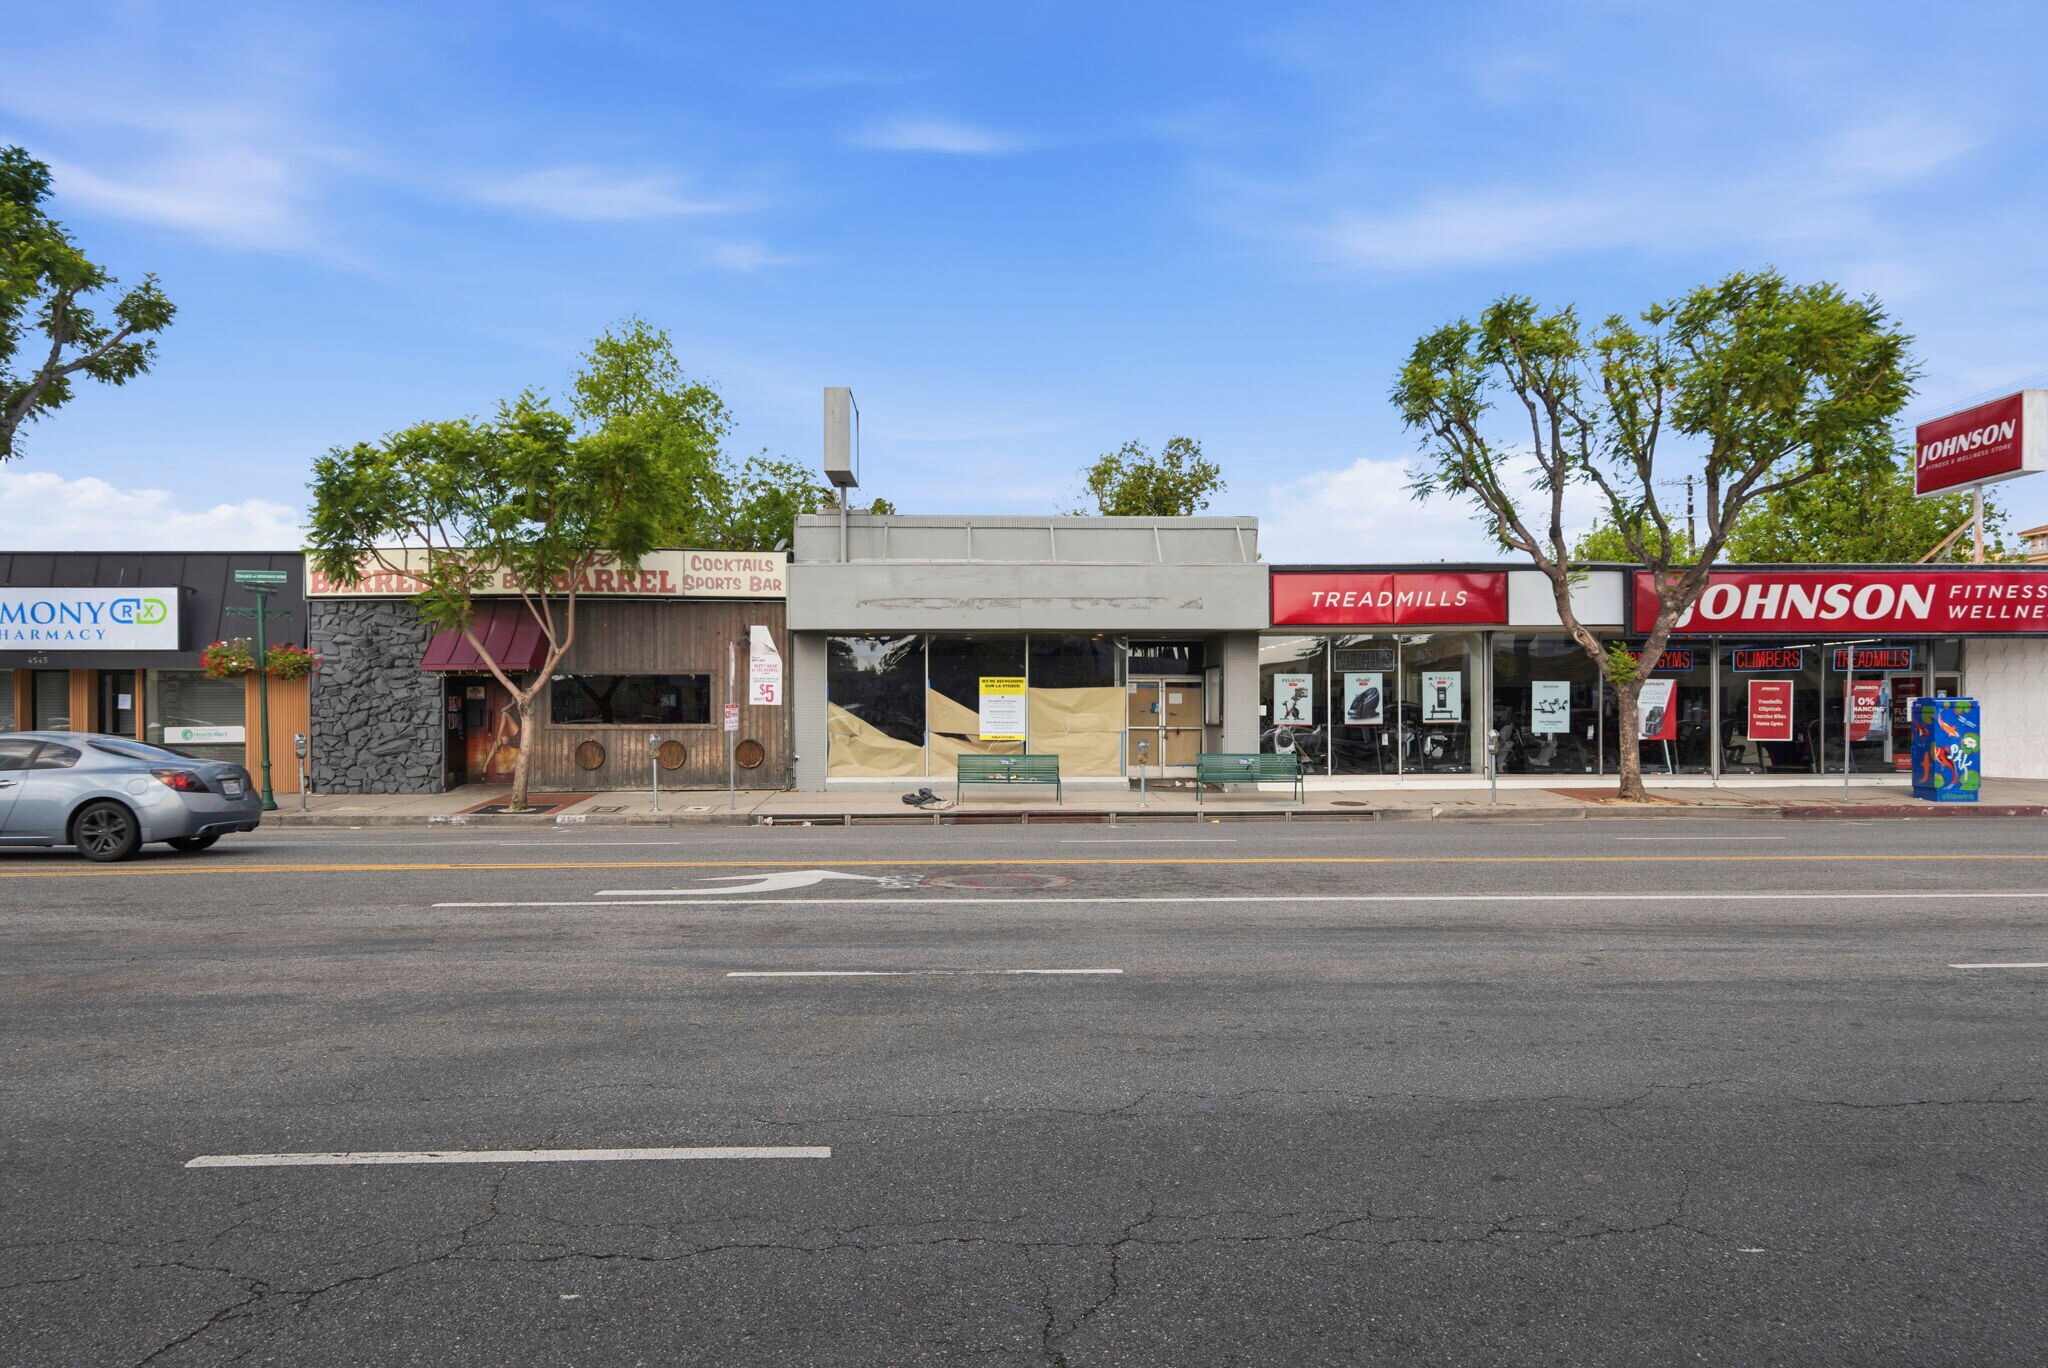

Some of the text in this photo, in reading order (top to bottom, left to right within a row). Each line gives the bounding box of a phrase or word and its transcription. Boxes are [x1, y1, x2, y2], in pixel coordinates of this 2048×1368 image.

[1919, 418, 2016, 468] JOHNSON
[1926, 460, 1949, 471] FITNESS
[1957, 449, 1988, 462] WELLNESS
[1990, 443, 2012, 454] STORE
[691, 555, 774, 573] COCKTAILS
[683, 574, 782, 592] SPORTS BAR
[1949, 585, 2048, 599] FITNESS
[1312, 590, 1468, 607] TREADMILLS
[1949, 605, 2048, 619] WELLNE
[28, 656, 48, 664] 4545
[1736, 650, 1800, 668] CLIMBERS
[1836, 650, 1909, 668] TREADMILLS
[760, 684, 774, 702] $5
[1858, 697, 1875, 706] 0%
